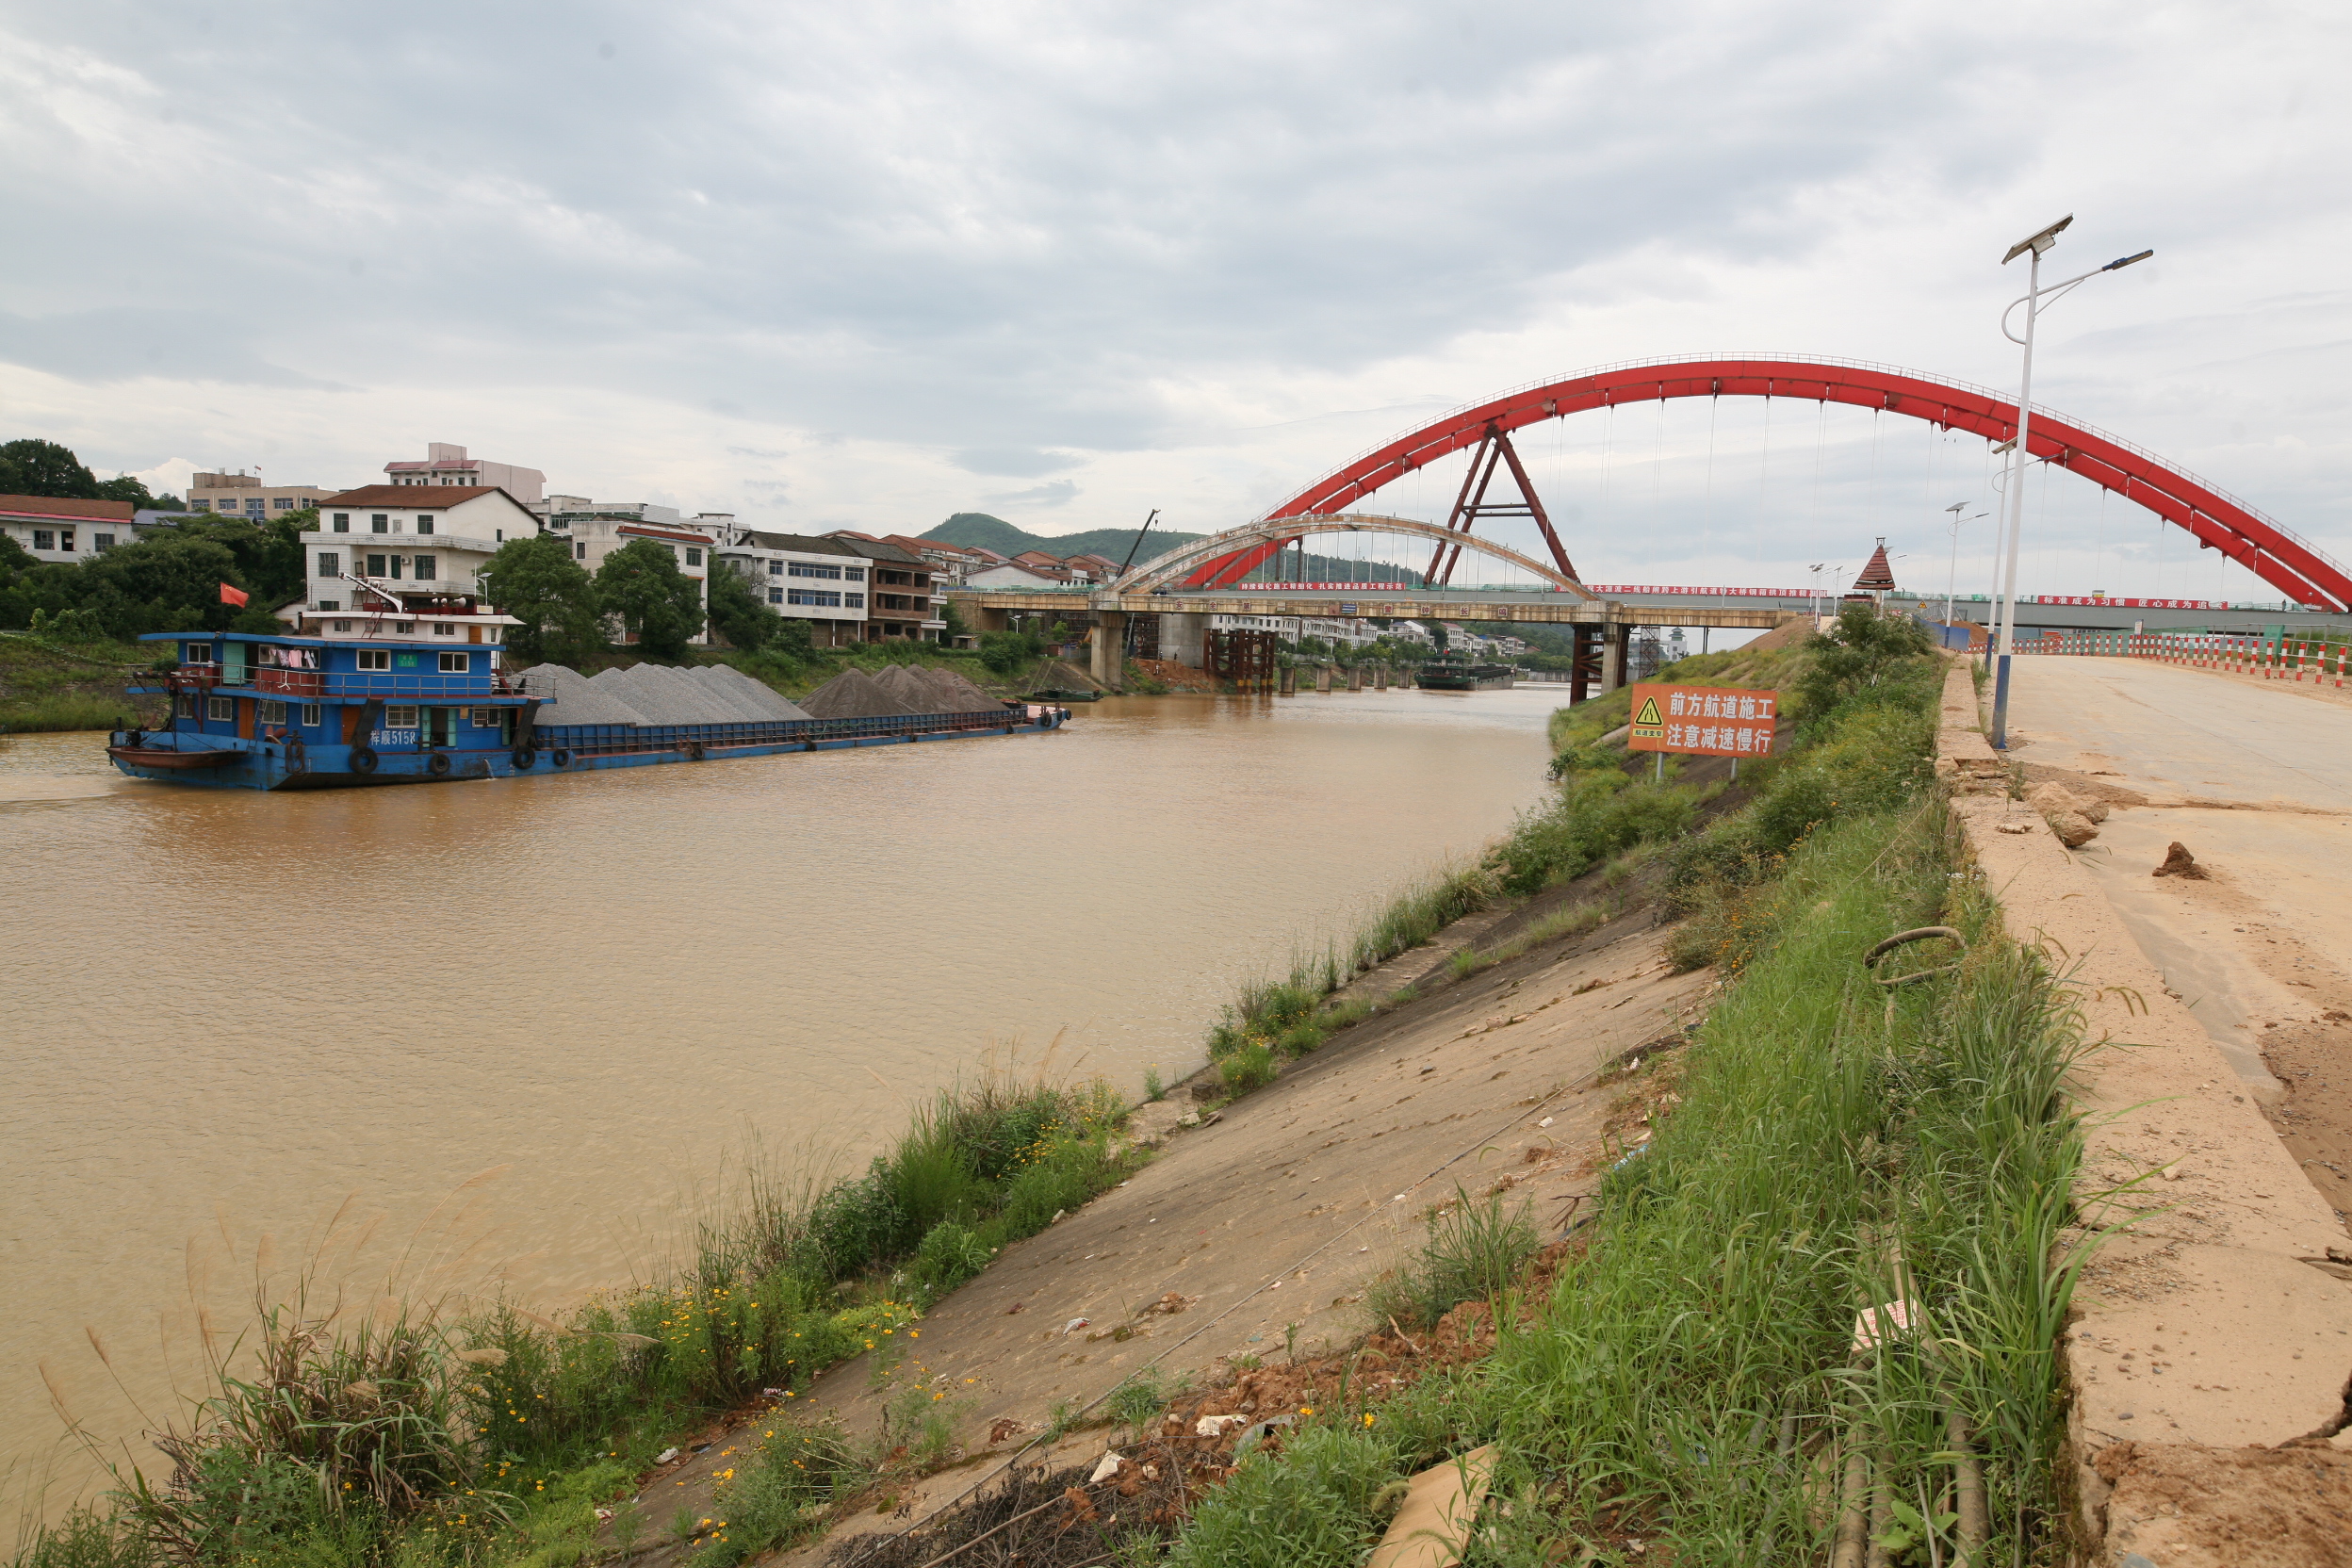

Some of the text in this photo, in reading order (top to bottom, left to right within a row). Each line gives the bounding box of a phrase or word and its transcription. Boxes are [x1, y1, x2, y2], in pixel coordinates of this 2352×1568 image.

[2043, 596, 2125, 607] 标准成为习惯
[1670, 692, 1772, 720] 前方航道施工
[1666, 724, 1771, 753] 注意减速慢行
